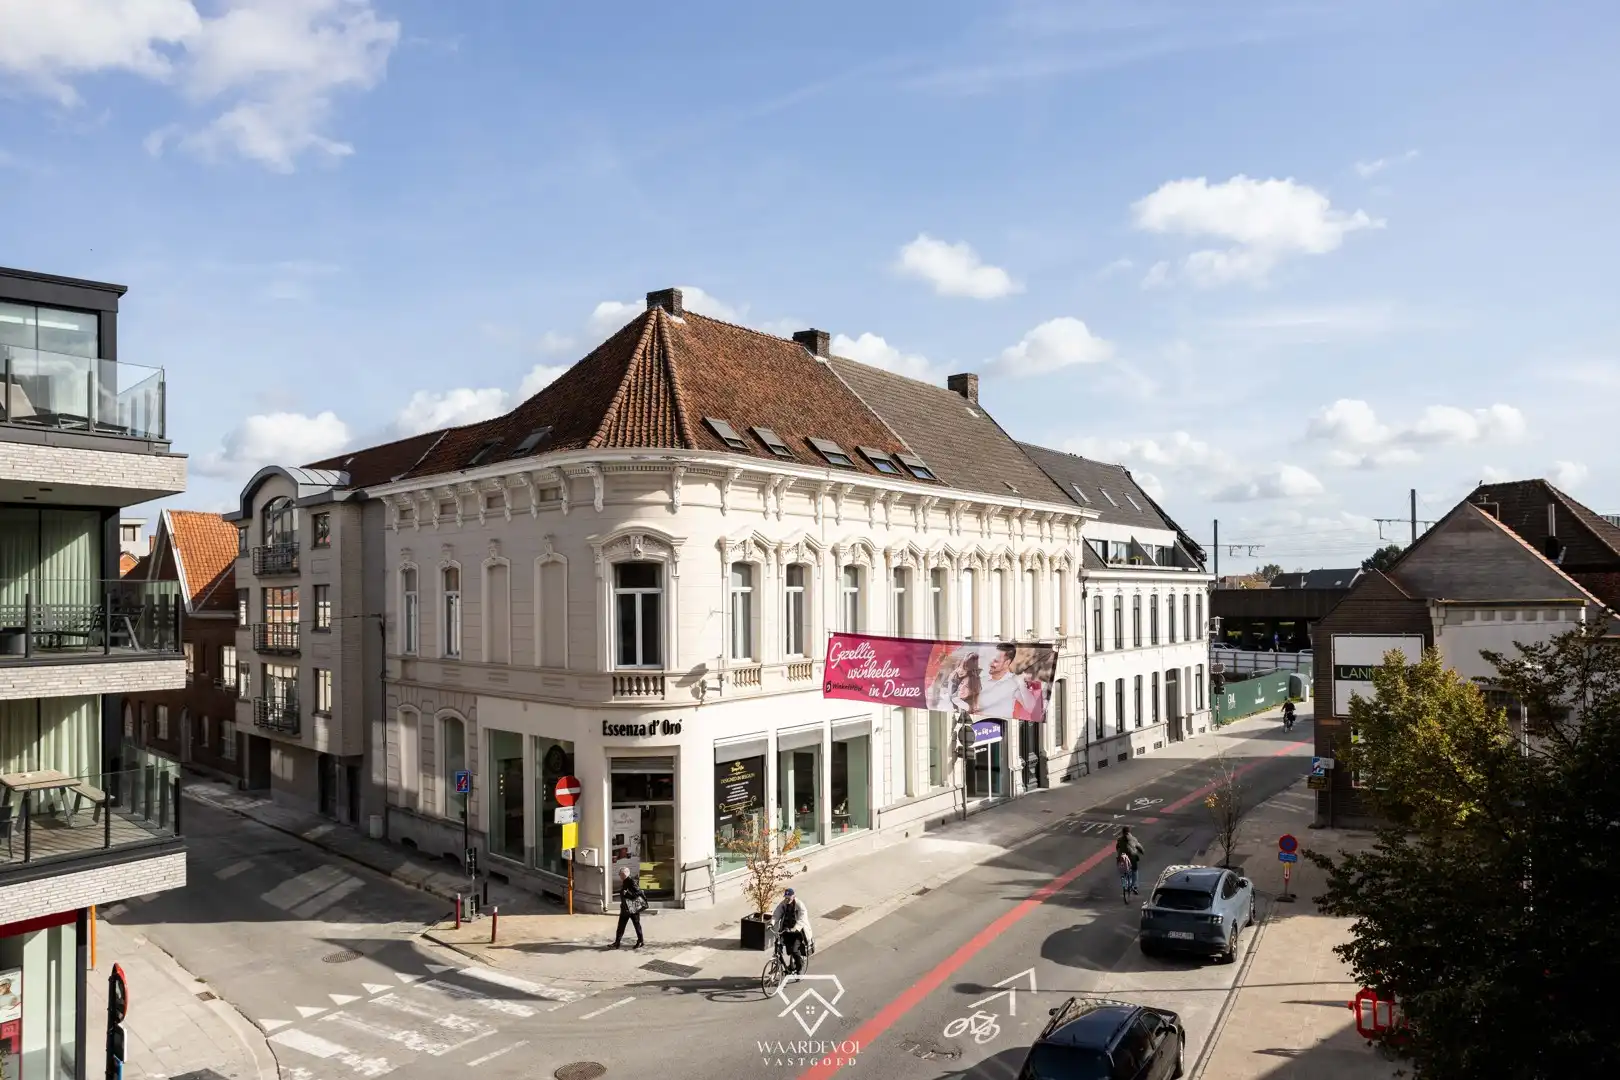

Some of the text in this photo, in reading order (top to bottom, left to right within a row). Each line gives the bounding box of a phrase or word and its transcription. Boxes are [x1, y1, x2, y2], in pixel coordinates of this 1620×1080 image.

[829, 641, 877, 669] Gezellig
[847, 660, 901, 679] winkelen
[868, 679, 921, 698] in Deinze
[602, 719, 646, 737] Essenza
